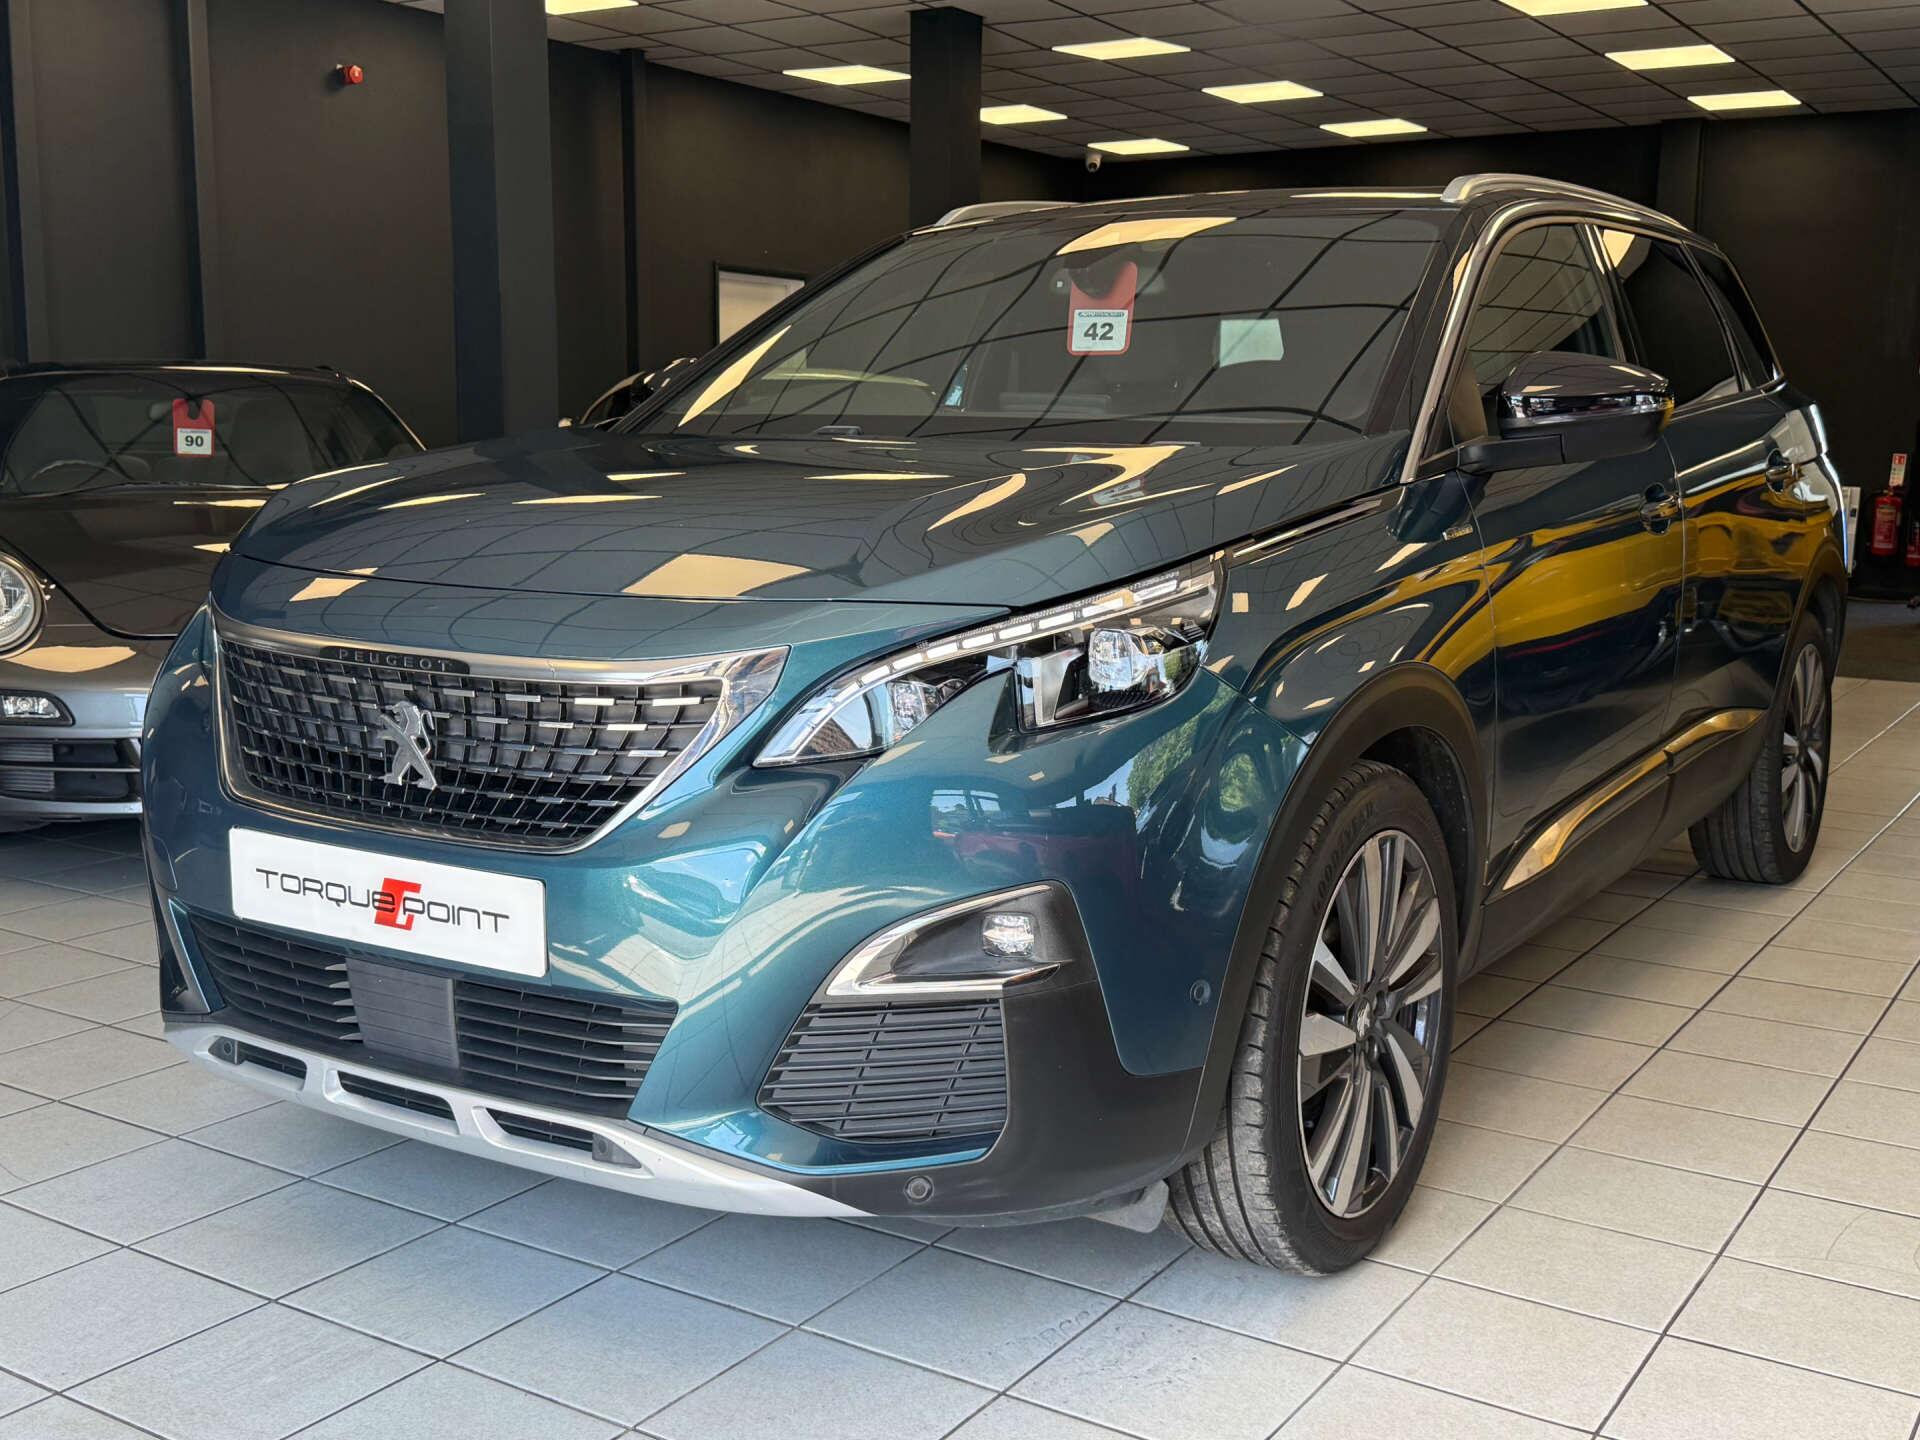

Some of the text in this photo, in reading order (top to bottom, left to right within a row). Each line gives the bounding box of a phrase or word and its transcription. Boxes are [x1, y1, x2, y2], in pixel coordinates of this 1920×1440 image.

[1083, 322, 1114, 341] 42
[184, 435, 204, 447] 90
[339, 648, 450, 673] PEUGEOT
